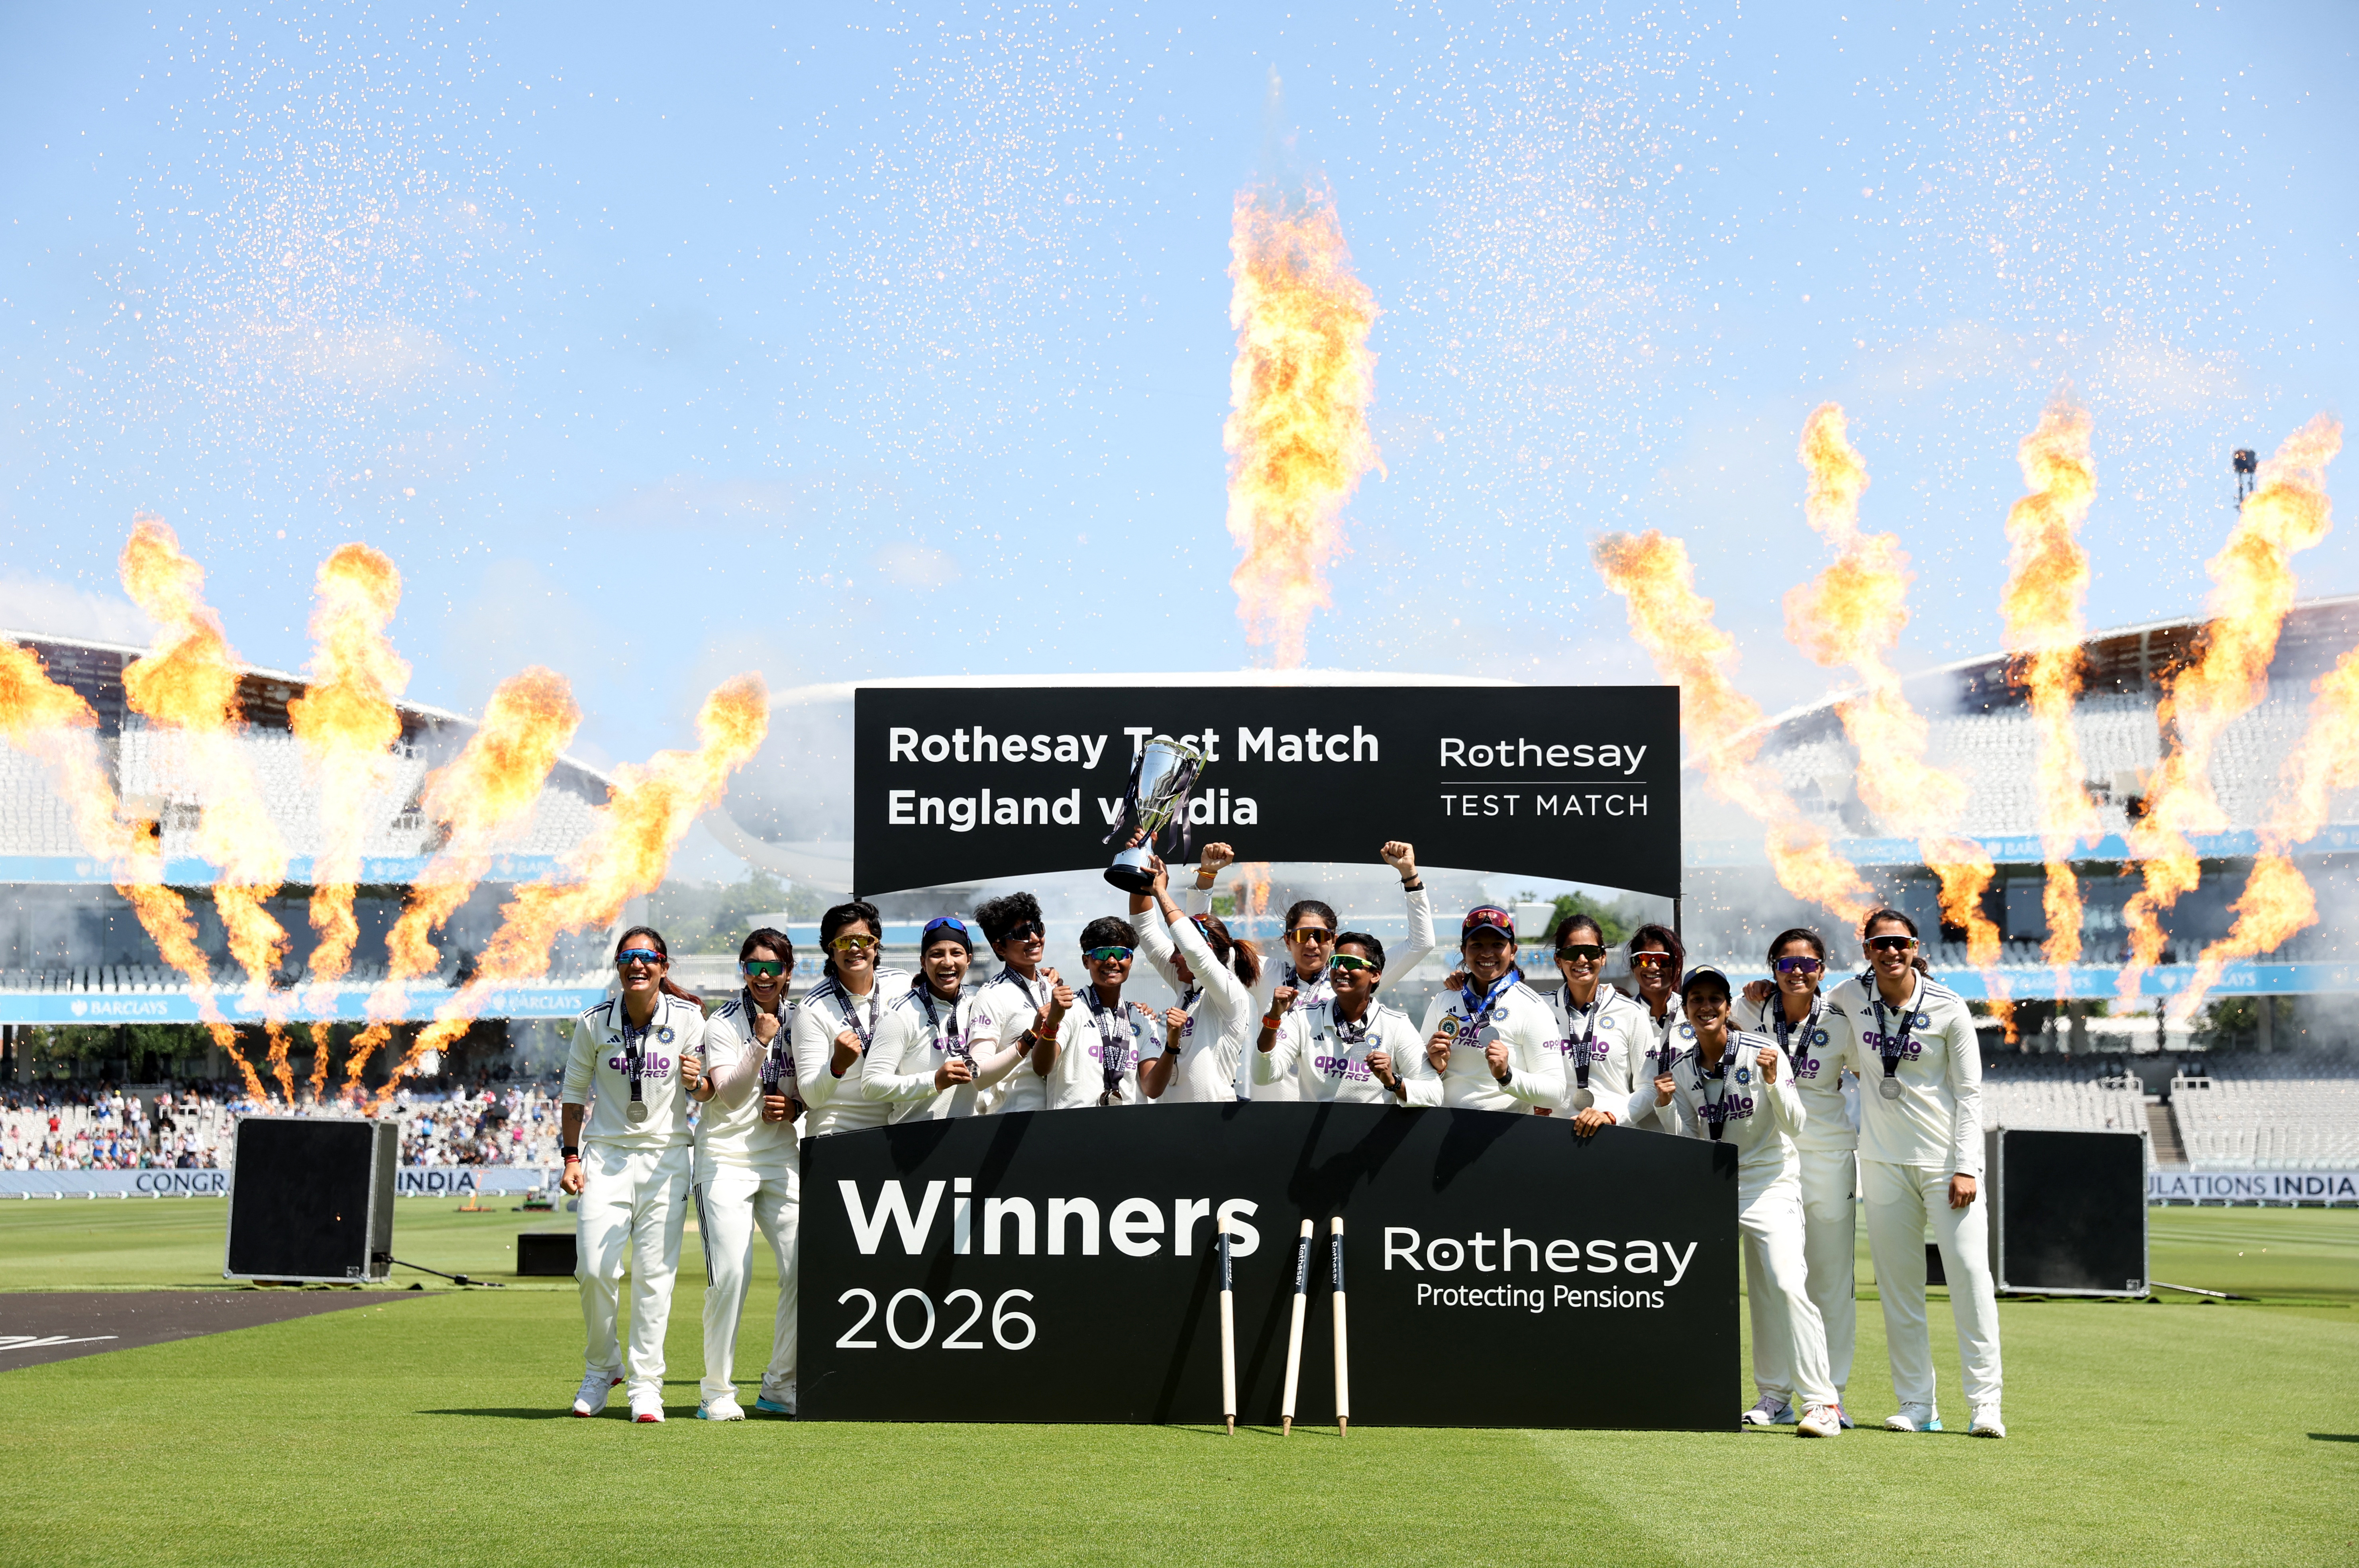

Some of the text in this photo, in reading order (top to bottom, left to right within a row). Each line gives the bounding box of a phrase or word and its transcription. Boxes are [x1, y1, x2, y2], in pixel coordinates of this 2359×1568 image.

[890, 726, 1107, 769] Rothesay
[1124, 727, 1219, 766] Tst
[1239, 726, 1378, 762] Match
[1441, 738, 1647, 774] Rothesay
[889, 789, 1079, 832] England
[1098, 798, 1124, 825] v
[1441, 795, 1647, 815] TEST MATCH
[1140, 828, 1153, 844] Rothesay
[1010, 976, 1021, 986] MATCH
[1494, 979, 1510, 992] BCCI
[91, 1000, 167, 1015] BARCLAYS
[839, 999, 852, 1020] Rothesay
[1113, 1016, 1121, 1037] Rothesay
[1804, 1024, 1815, 1048] Rothesay
[1896, 1034, 1908, 1058] Rothesay
[609, 1053, 670, 1075] apllo
[1115, 1049, 1125, 1071] Rothesay
[1315, 1056, 1371, 1074] apollo
[1331, 1070, 1370, 1082] TYRES
[137, 1172, 475, 1192] CONGR INDIA
[2275, 1177, 2356, 1195] INDIA
[838, 1178, 1260, 1257] Winners
[1295, 1244, 1306, 1286] Rothesay
[1384, 1227, 1698, 1286] Rothesay
[1417, 1284, 1664, 1313] Protecting Pensions
[836, 1288, 1036, 1350] 2026
